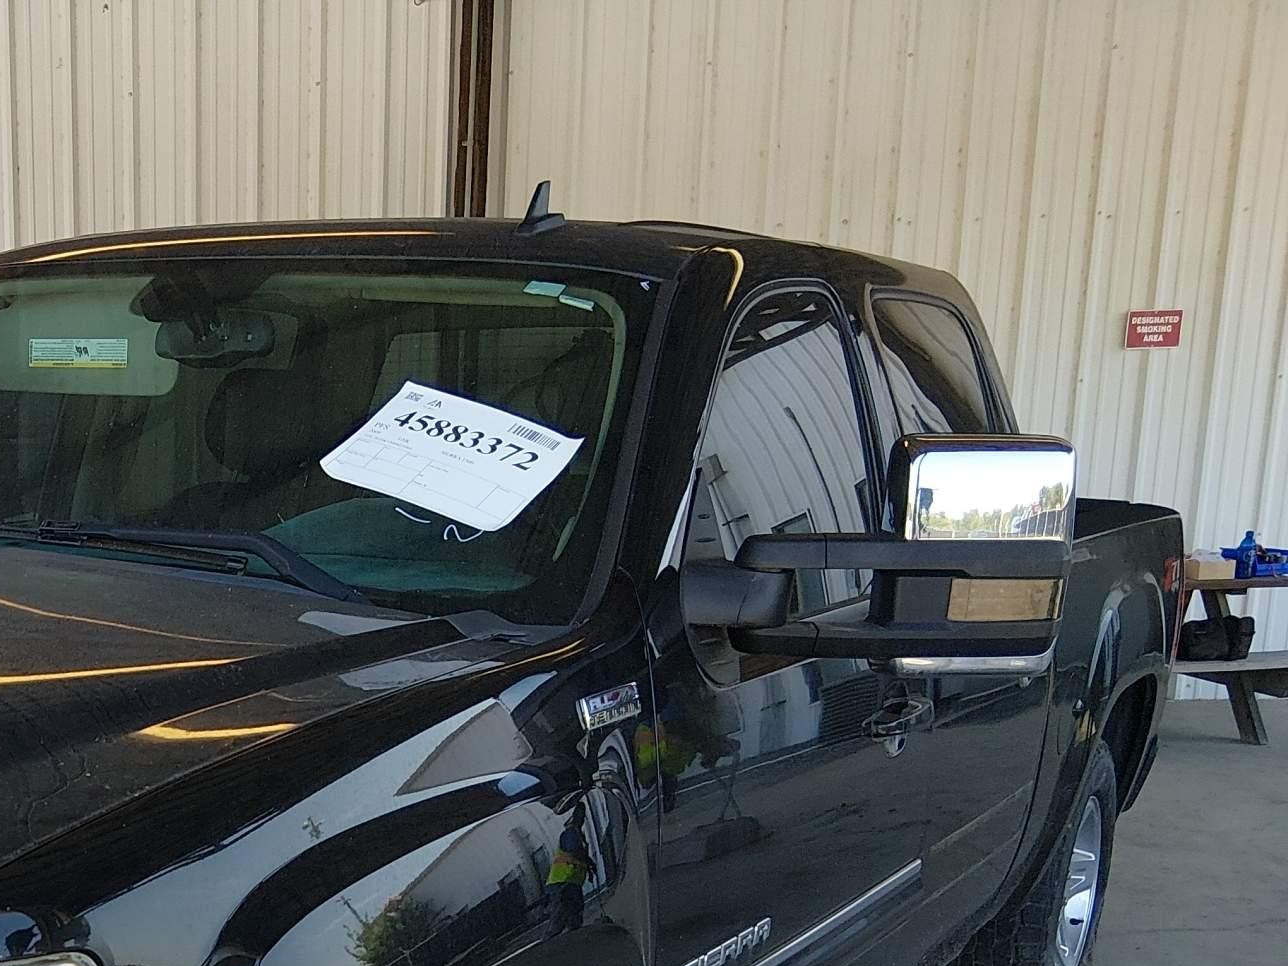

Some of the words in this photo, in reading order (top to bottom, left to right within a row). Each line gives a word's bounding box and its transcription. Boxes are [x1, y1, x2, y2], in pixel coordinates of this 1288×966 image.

[1132, 315, 1180, 325] DESIGNATED
[1136, 325, 1172, 334] SMOKING
[1142, 334, 1164, 342] AREA
[394, 411, 540, 471] 45883372
